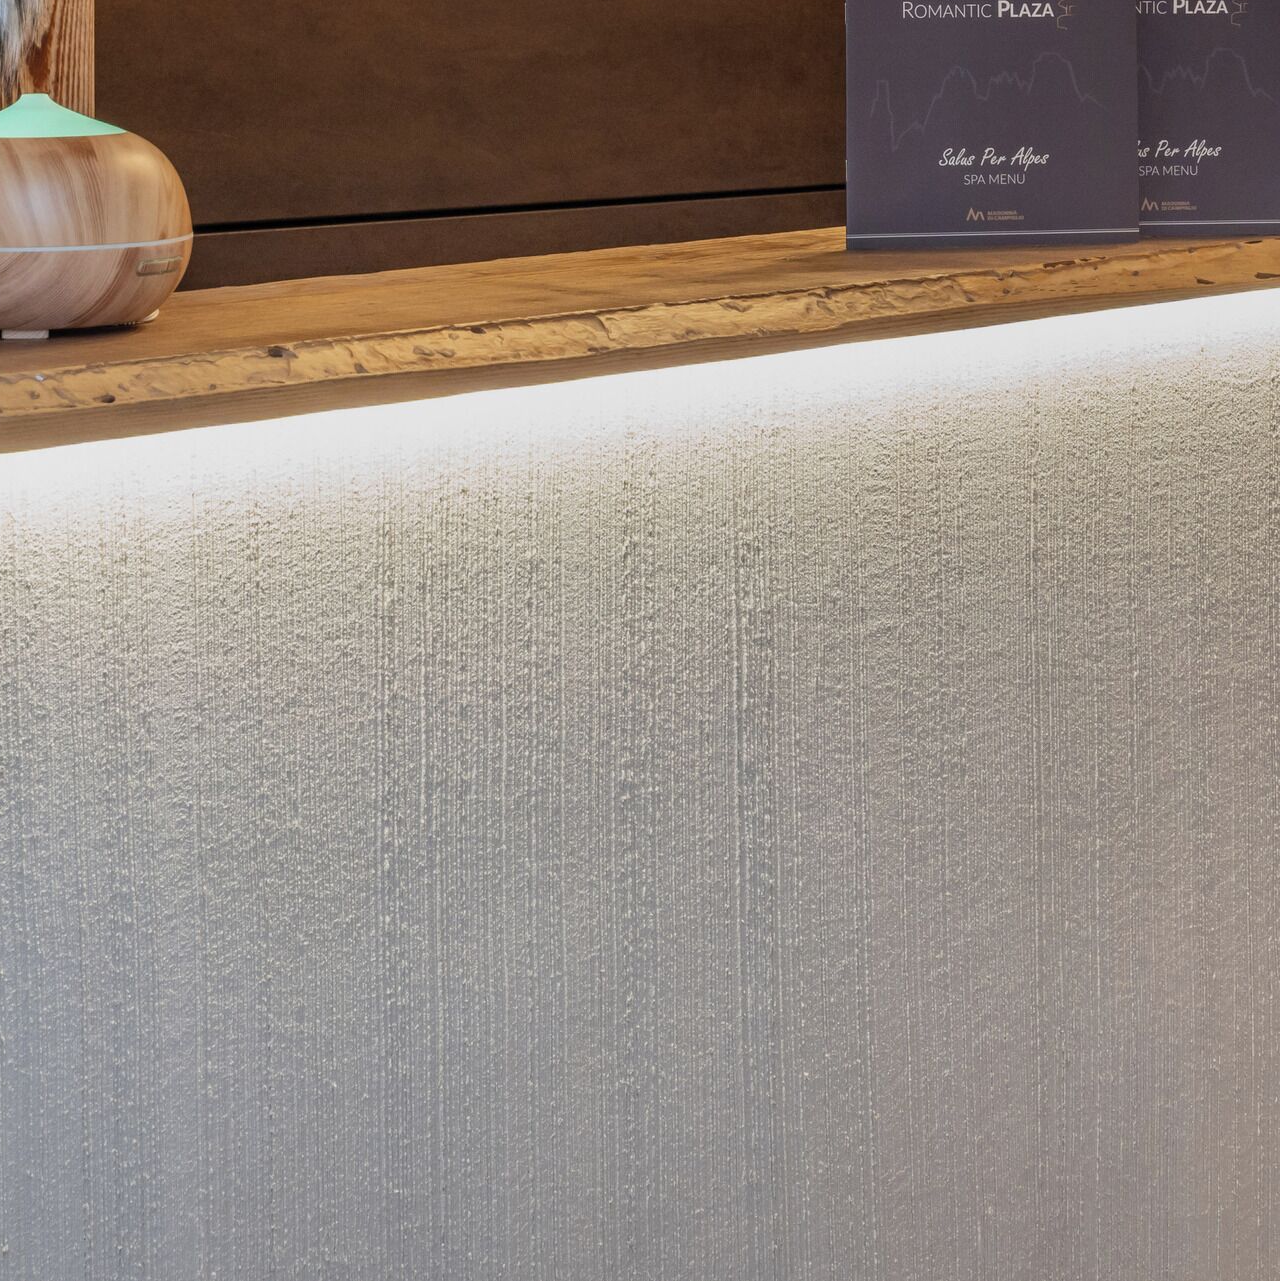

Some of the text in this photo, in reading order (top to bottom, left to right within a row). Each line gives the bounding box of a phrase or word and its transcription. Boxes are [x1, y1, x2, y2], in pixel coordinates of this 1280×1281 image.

[997, 0, 1055, 18] PLAZA
[939, 146, 1050, 172] Salus Per Alpes
[1154, 139, 1180, 158] Per
[1183, 138, 1222, 164] Alpes
[1138, 164, 1199, 176] SPA MENU
[963, 173, 1026, 186] SPA MENU
